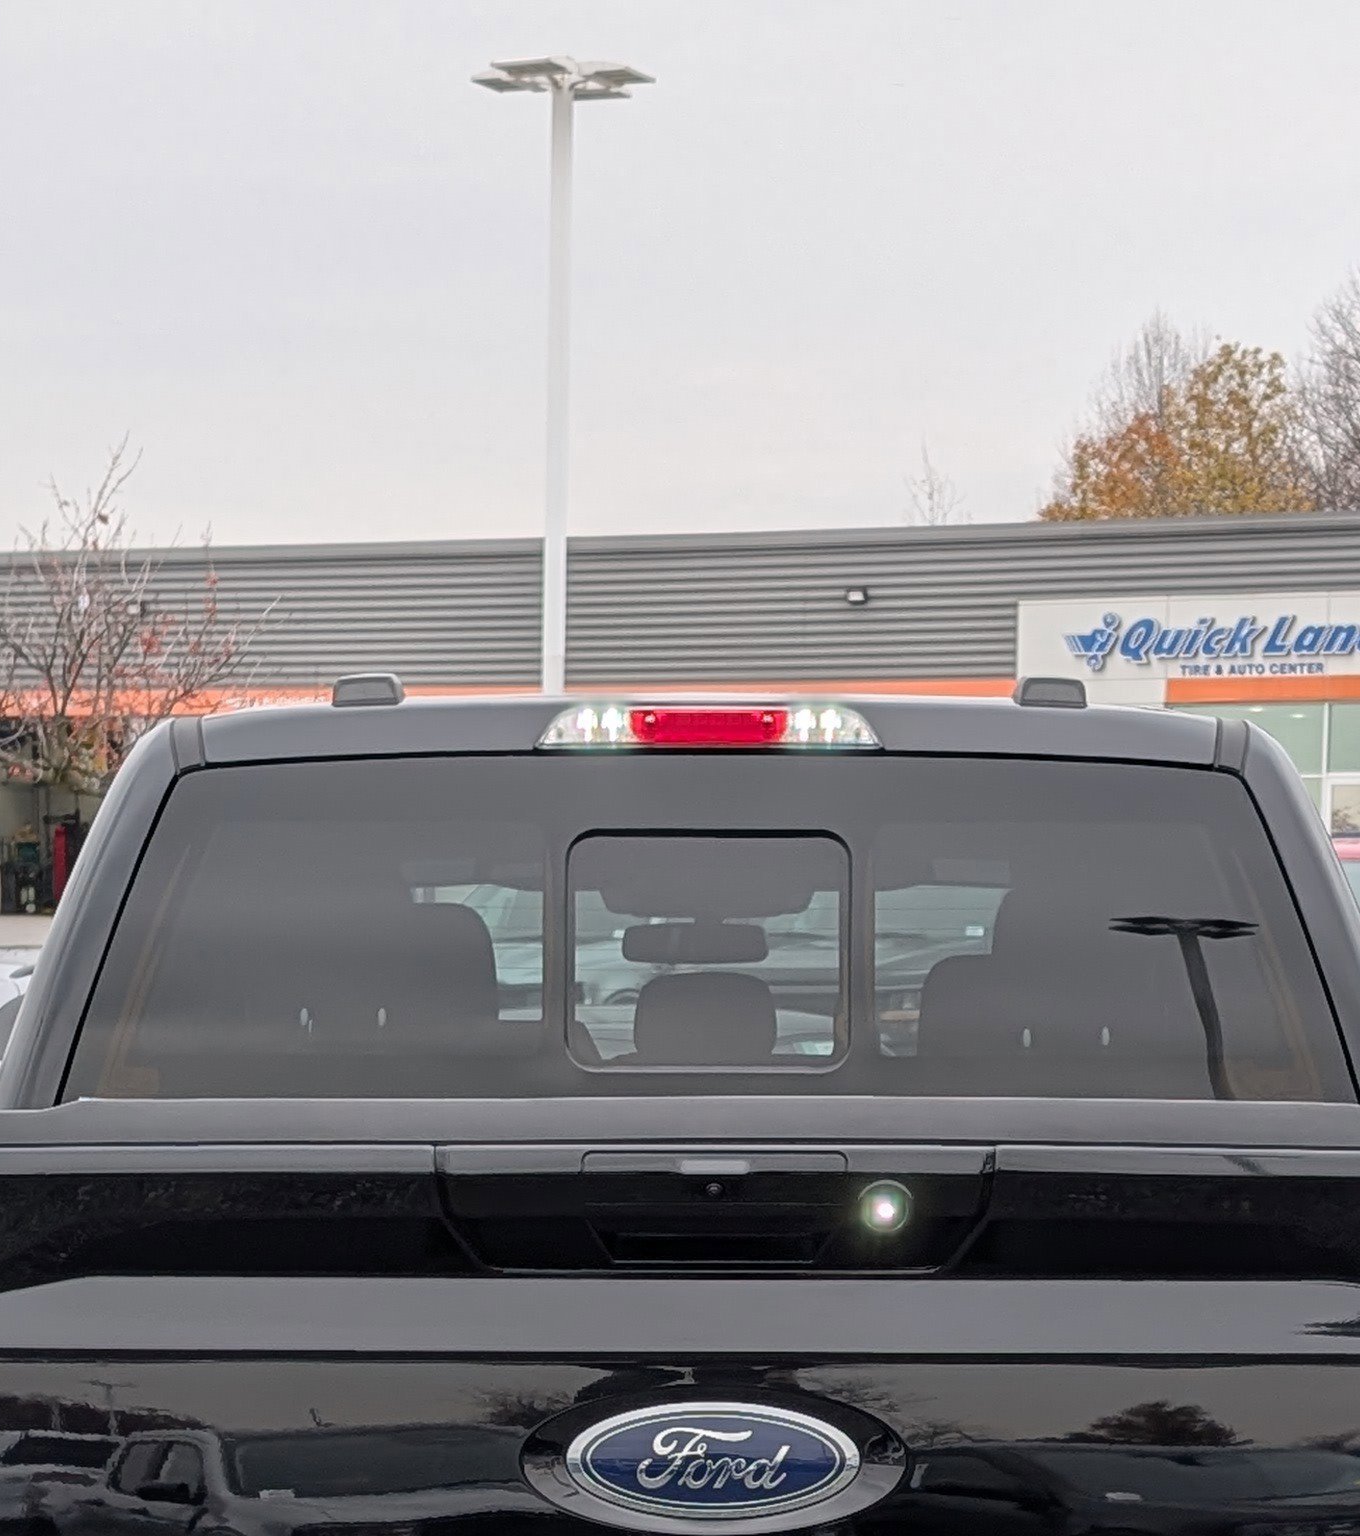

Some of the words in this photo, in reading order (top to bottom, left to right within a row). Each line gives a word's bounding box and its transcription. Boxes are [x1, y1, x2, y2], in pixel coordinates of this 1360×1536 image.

[1119, 615, 1265, 664] Quick
[1180, 664, 1211, 676] TIRE
[1229, 663, 1266, 676] AUTO
[1269, 662, 1325, 675] CENTER
[636, 1426, 791, 1490] Ford
